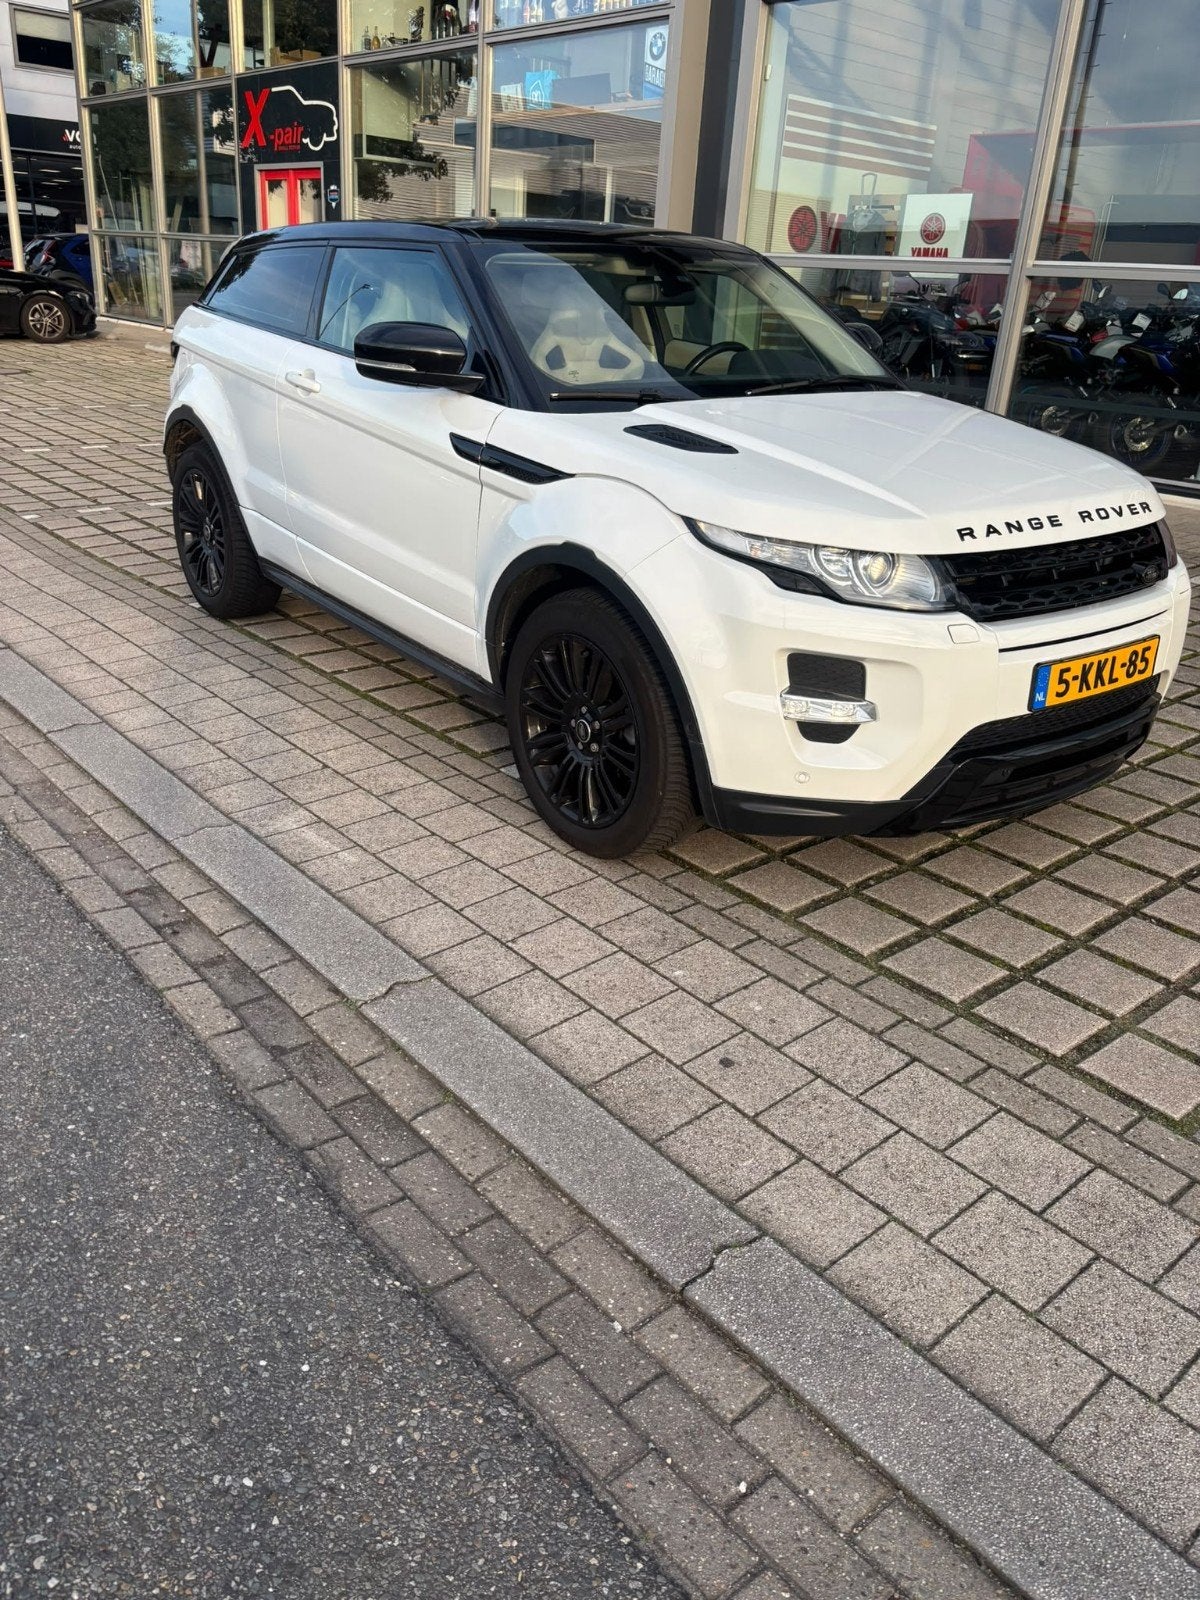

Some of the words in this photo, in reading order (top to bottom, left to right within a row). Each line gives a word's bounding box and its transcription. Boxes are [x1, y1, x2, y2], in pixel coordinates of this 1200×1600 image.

[644, 63, 666, 89] GARAG
[911, 246, 949, 258] YAMAHA
[956, 514, 1063, 542] RANGE
[1078, 501, 1153, 523] ROVER
[1055, 645, 1152, 698] 5-KKL-85
[1035, 691, 1046, 702] NL
